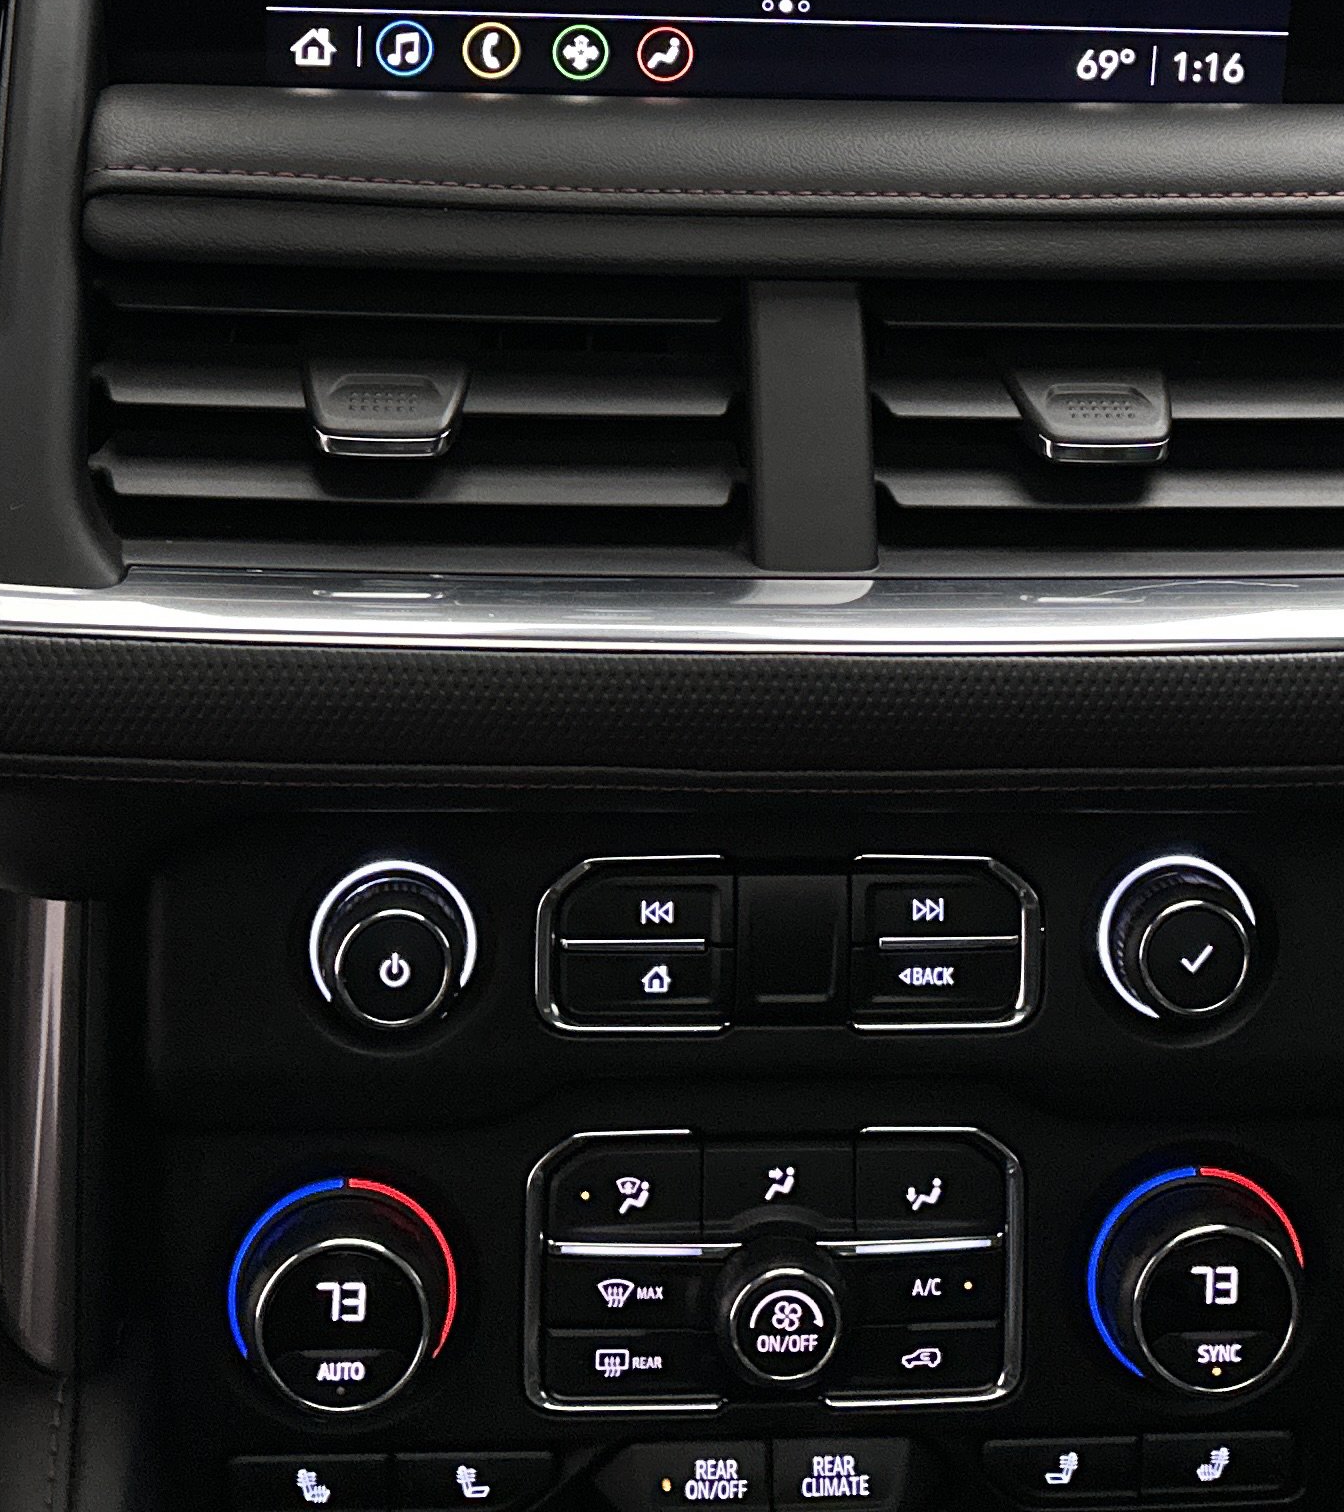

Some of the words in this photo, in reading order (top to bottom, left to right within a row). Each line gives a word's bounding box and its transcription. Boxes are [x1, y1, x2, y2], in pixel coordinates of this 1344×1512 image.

[1077, 49, 1135, 80] 69°
[1174, 52, 1244, 83] 1:16
[913, 967, 955, 985] BACK
[637, 1286, 663, 1299] MAX
[912, 1278, 941, 1296] A/C
[1191, 1266, 1238, 1304] 73
[316, 1282, 366, 1321] 73
[757, 1334, 818, 1353] ON/OFF
[632, 1356, 662, 1369] REAR
[1197, 1344, 1242, 1364] SYNC
[316, 1362, 365, 1381] AUTO
[695, 1460, 738, 1479] REAR
[812, 1456, 855, 1476] REAR
[684, 1480, 748, 1500] ON/OFF
[801, 1477, 869, 1497] CLIMATE
